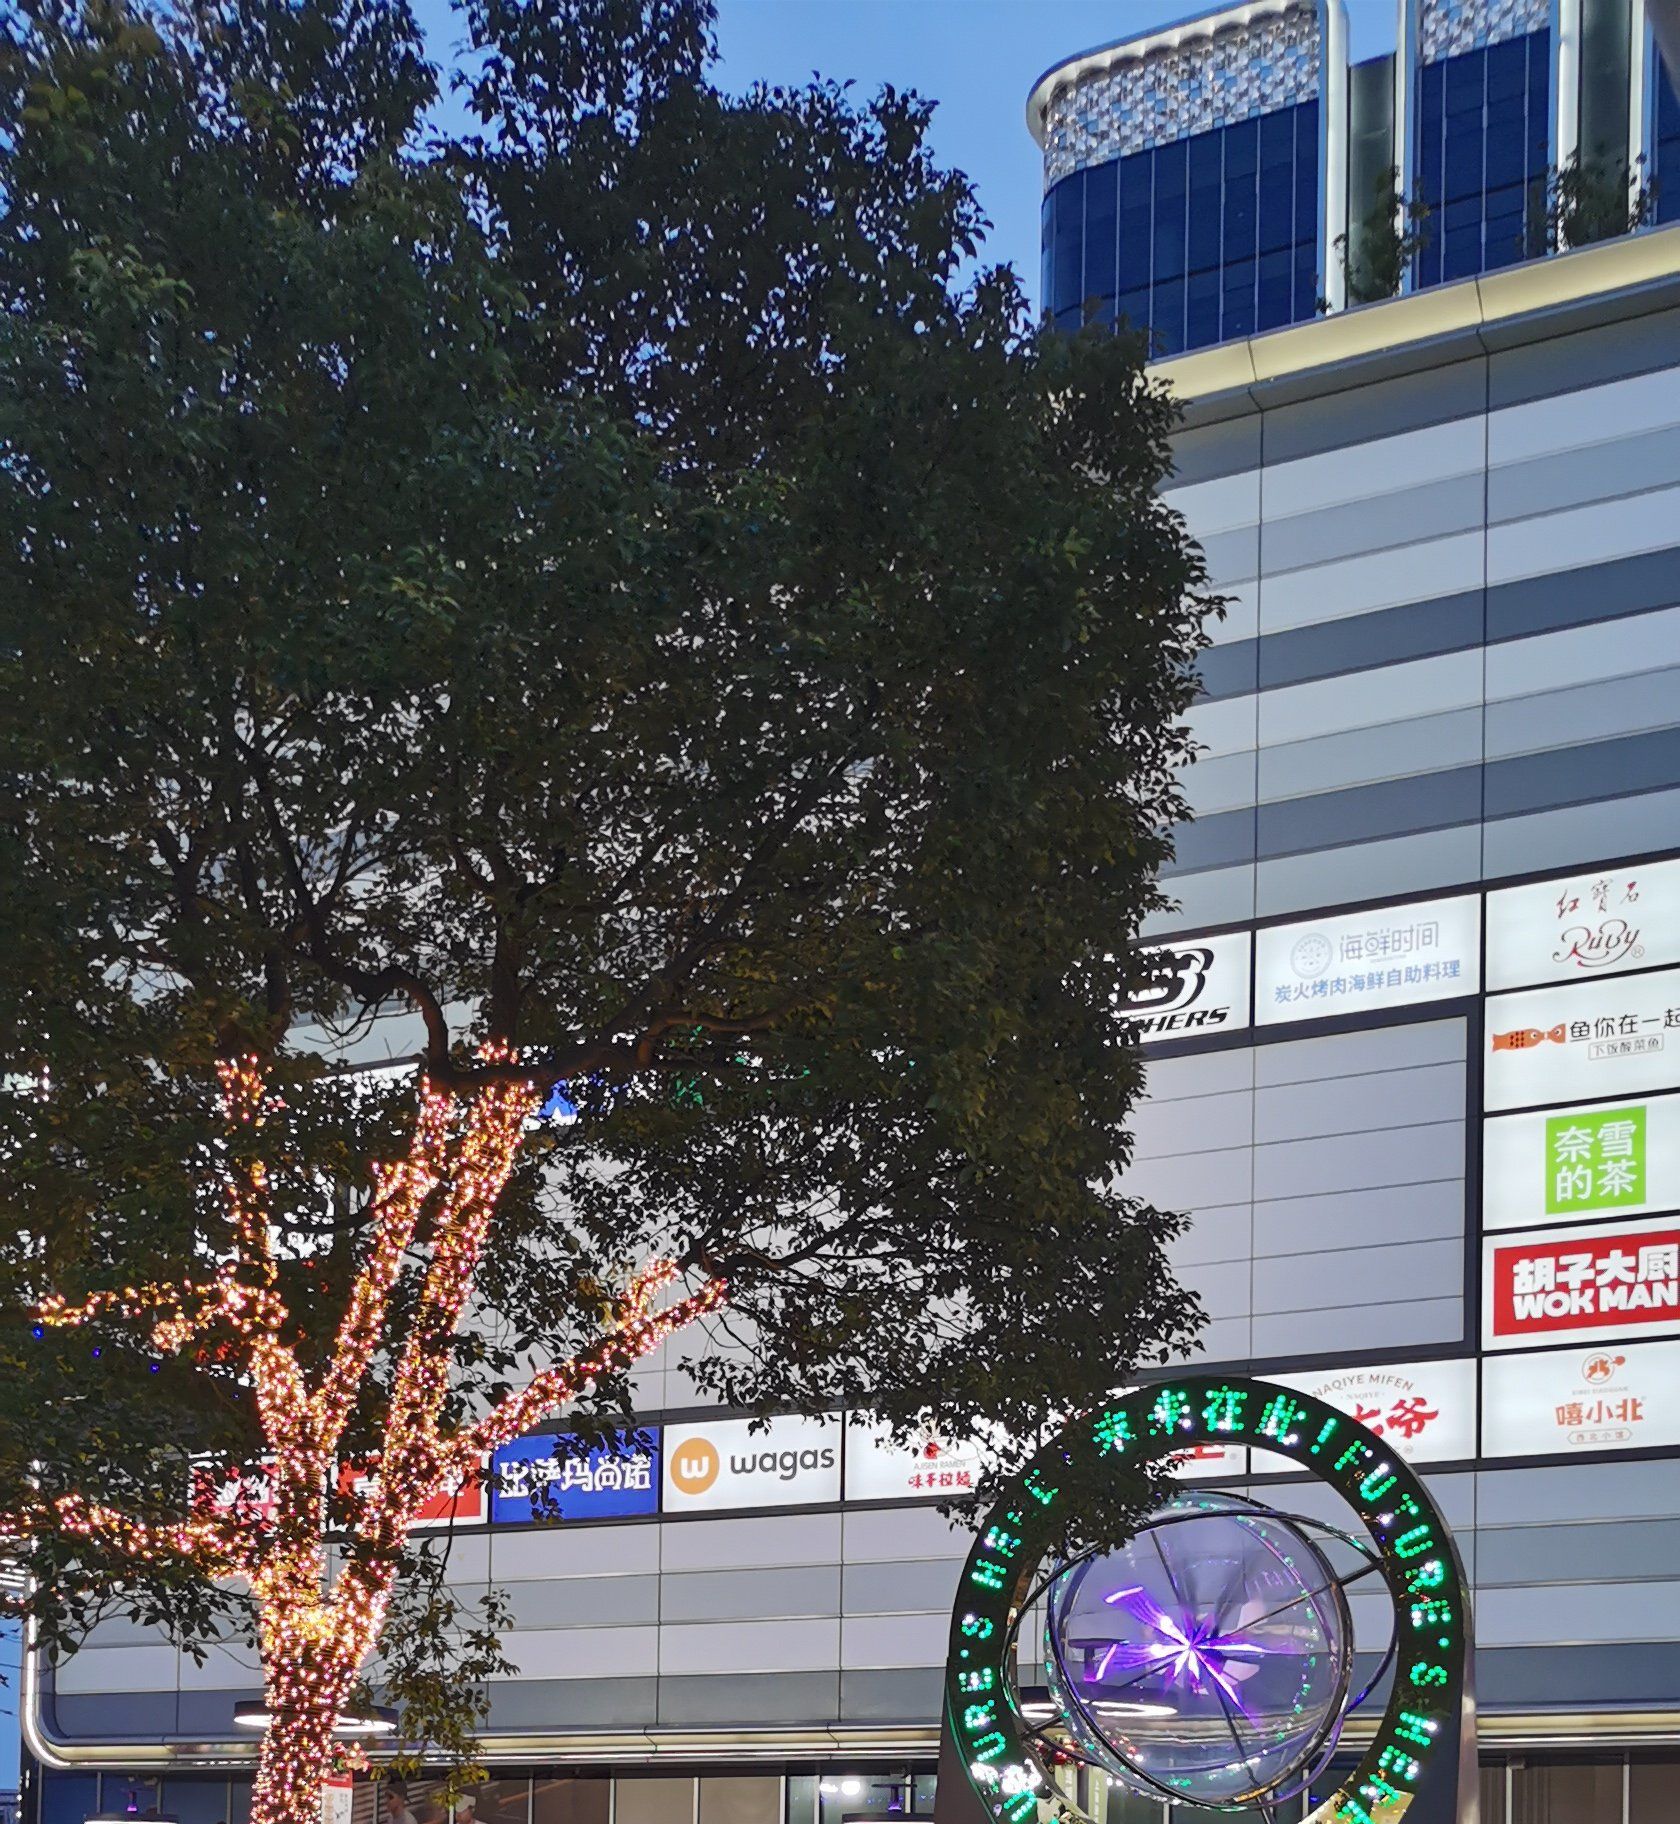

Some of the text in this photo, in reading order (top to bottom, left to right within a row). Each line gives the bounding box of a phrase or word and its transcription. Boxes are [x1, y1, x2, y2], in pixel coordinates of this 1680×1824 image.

[1339, 921, 1440, 963] 海鲜时间
[1275, 959, 1461, 1004] 炭火烤肉海鲜自助料理
[1512, 1243, 1679, 1295] 胡子大厨
[1512, 1280, 1679, 1321] WOK MAN
[1312, 1373, 1415, 1399] NAQIYE MIFEN
[1555, 1397, 1644, 1426] 嘻小北
[730, 1448, 835, 1481] wagas
